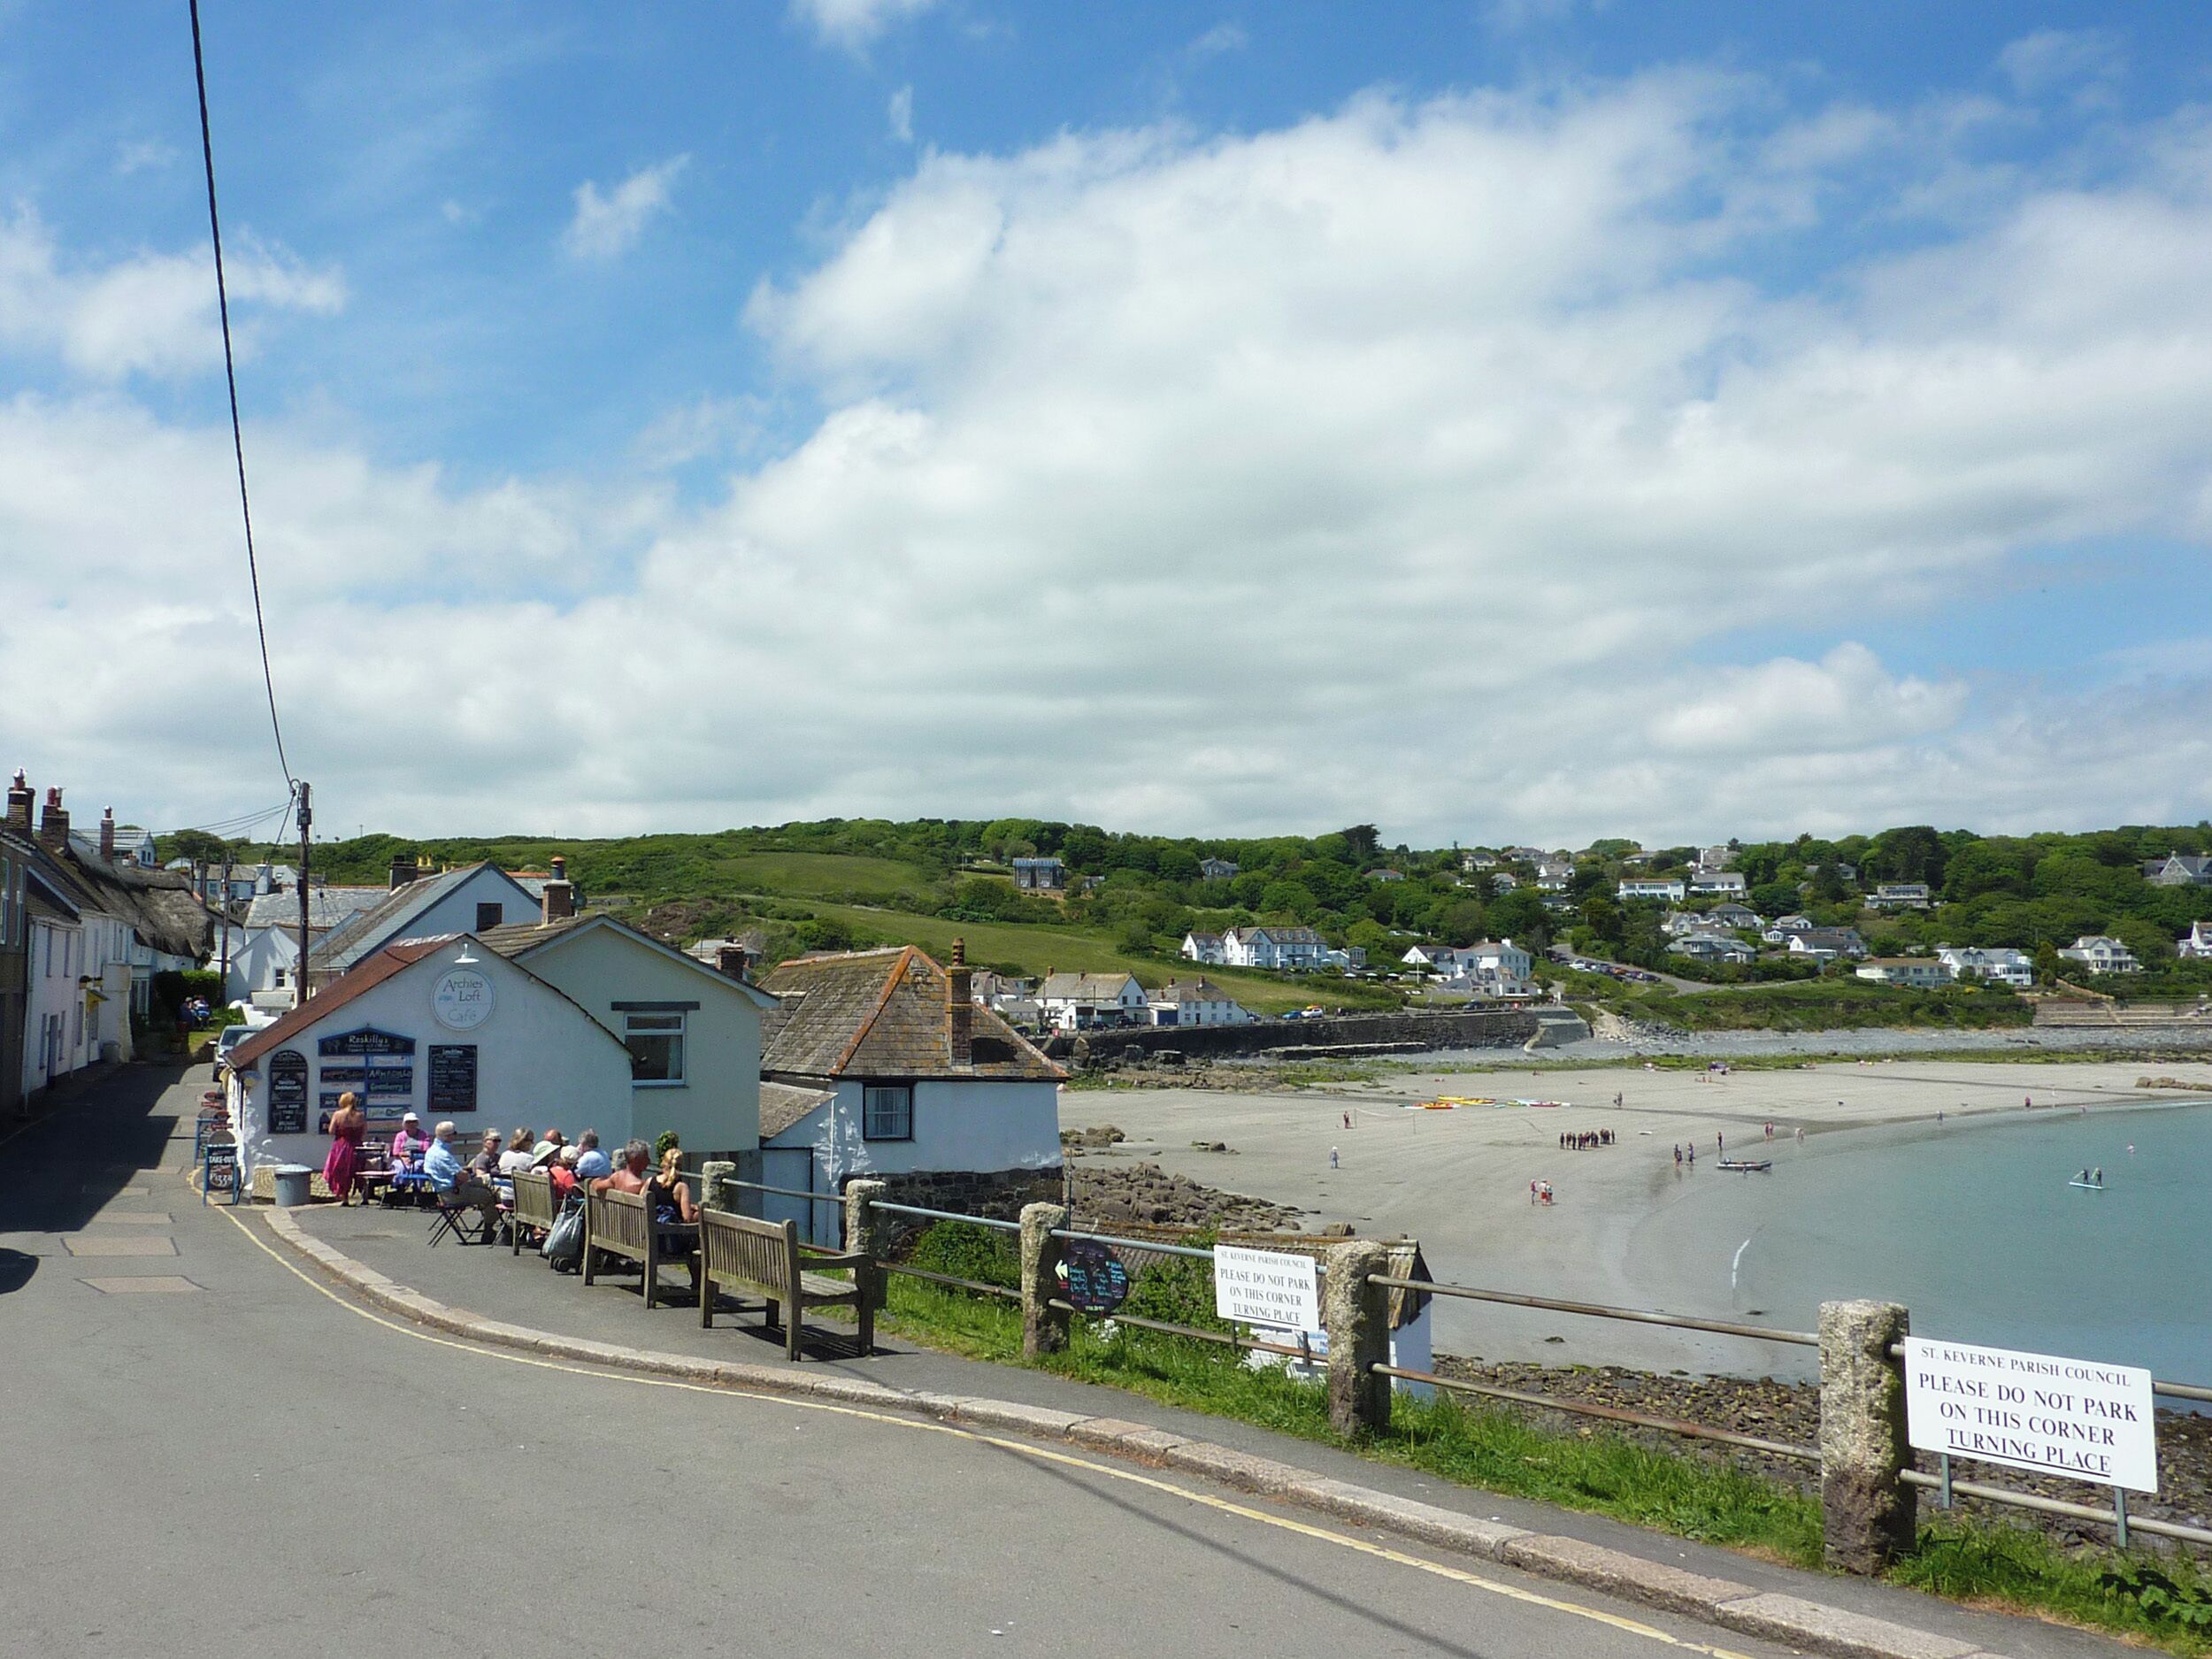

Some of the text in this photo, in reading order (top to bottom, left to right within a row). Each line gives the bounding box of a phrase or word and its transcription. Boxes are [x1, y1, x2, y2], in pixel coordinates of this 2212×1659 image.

[442, 978, 483, 992] Archies
[459, 989, 481, 1002] Loft
[1230, 1253, 1256, 1262] KEVERNE
[1258, 1256, 1279, 1265] PARISH
[1280, 1259, 1307, 1269] COUNCIL
[1220, 1268, 1310, 1291] PLEASE DO NOT PARK
[1230, 1286, 1302, 1307] ON THIS CORNER
[1233, 1303, 1301, 1323] TURNING PLACE
[1921, 1347, 2131, 1386] ST. KEVERNE PARISH COUNCIL
[1919, 1373, 2139, 1422] PLEASE DO NOT PARK
[1940, 1402, 2116, 1446] ON THIS CORNER
[1946, 1428, 2111, 1473] TURNING PLACE
